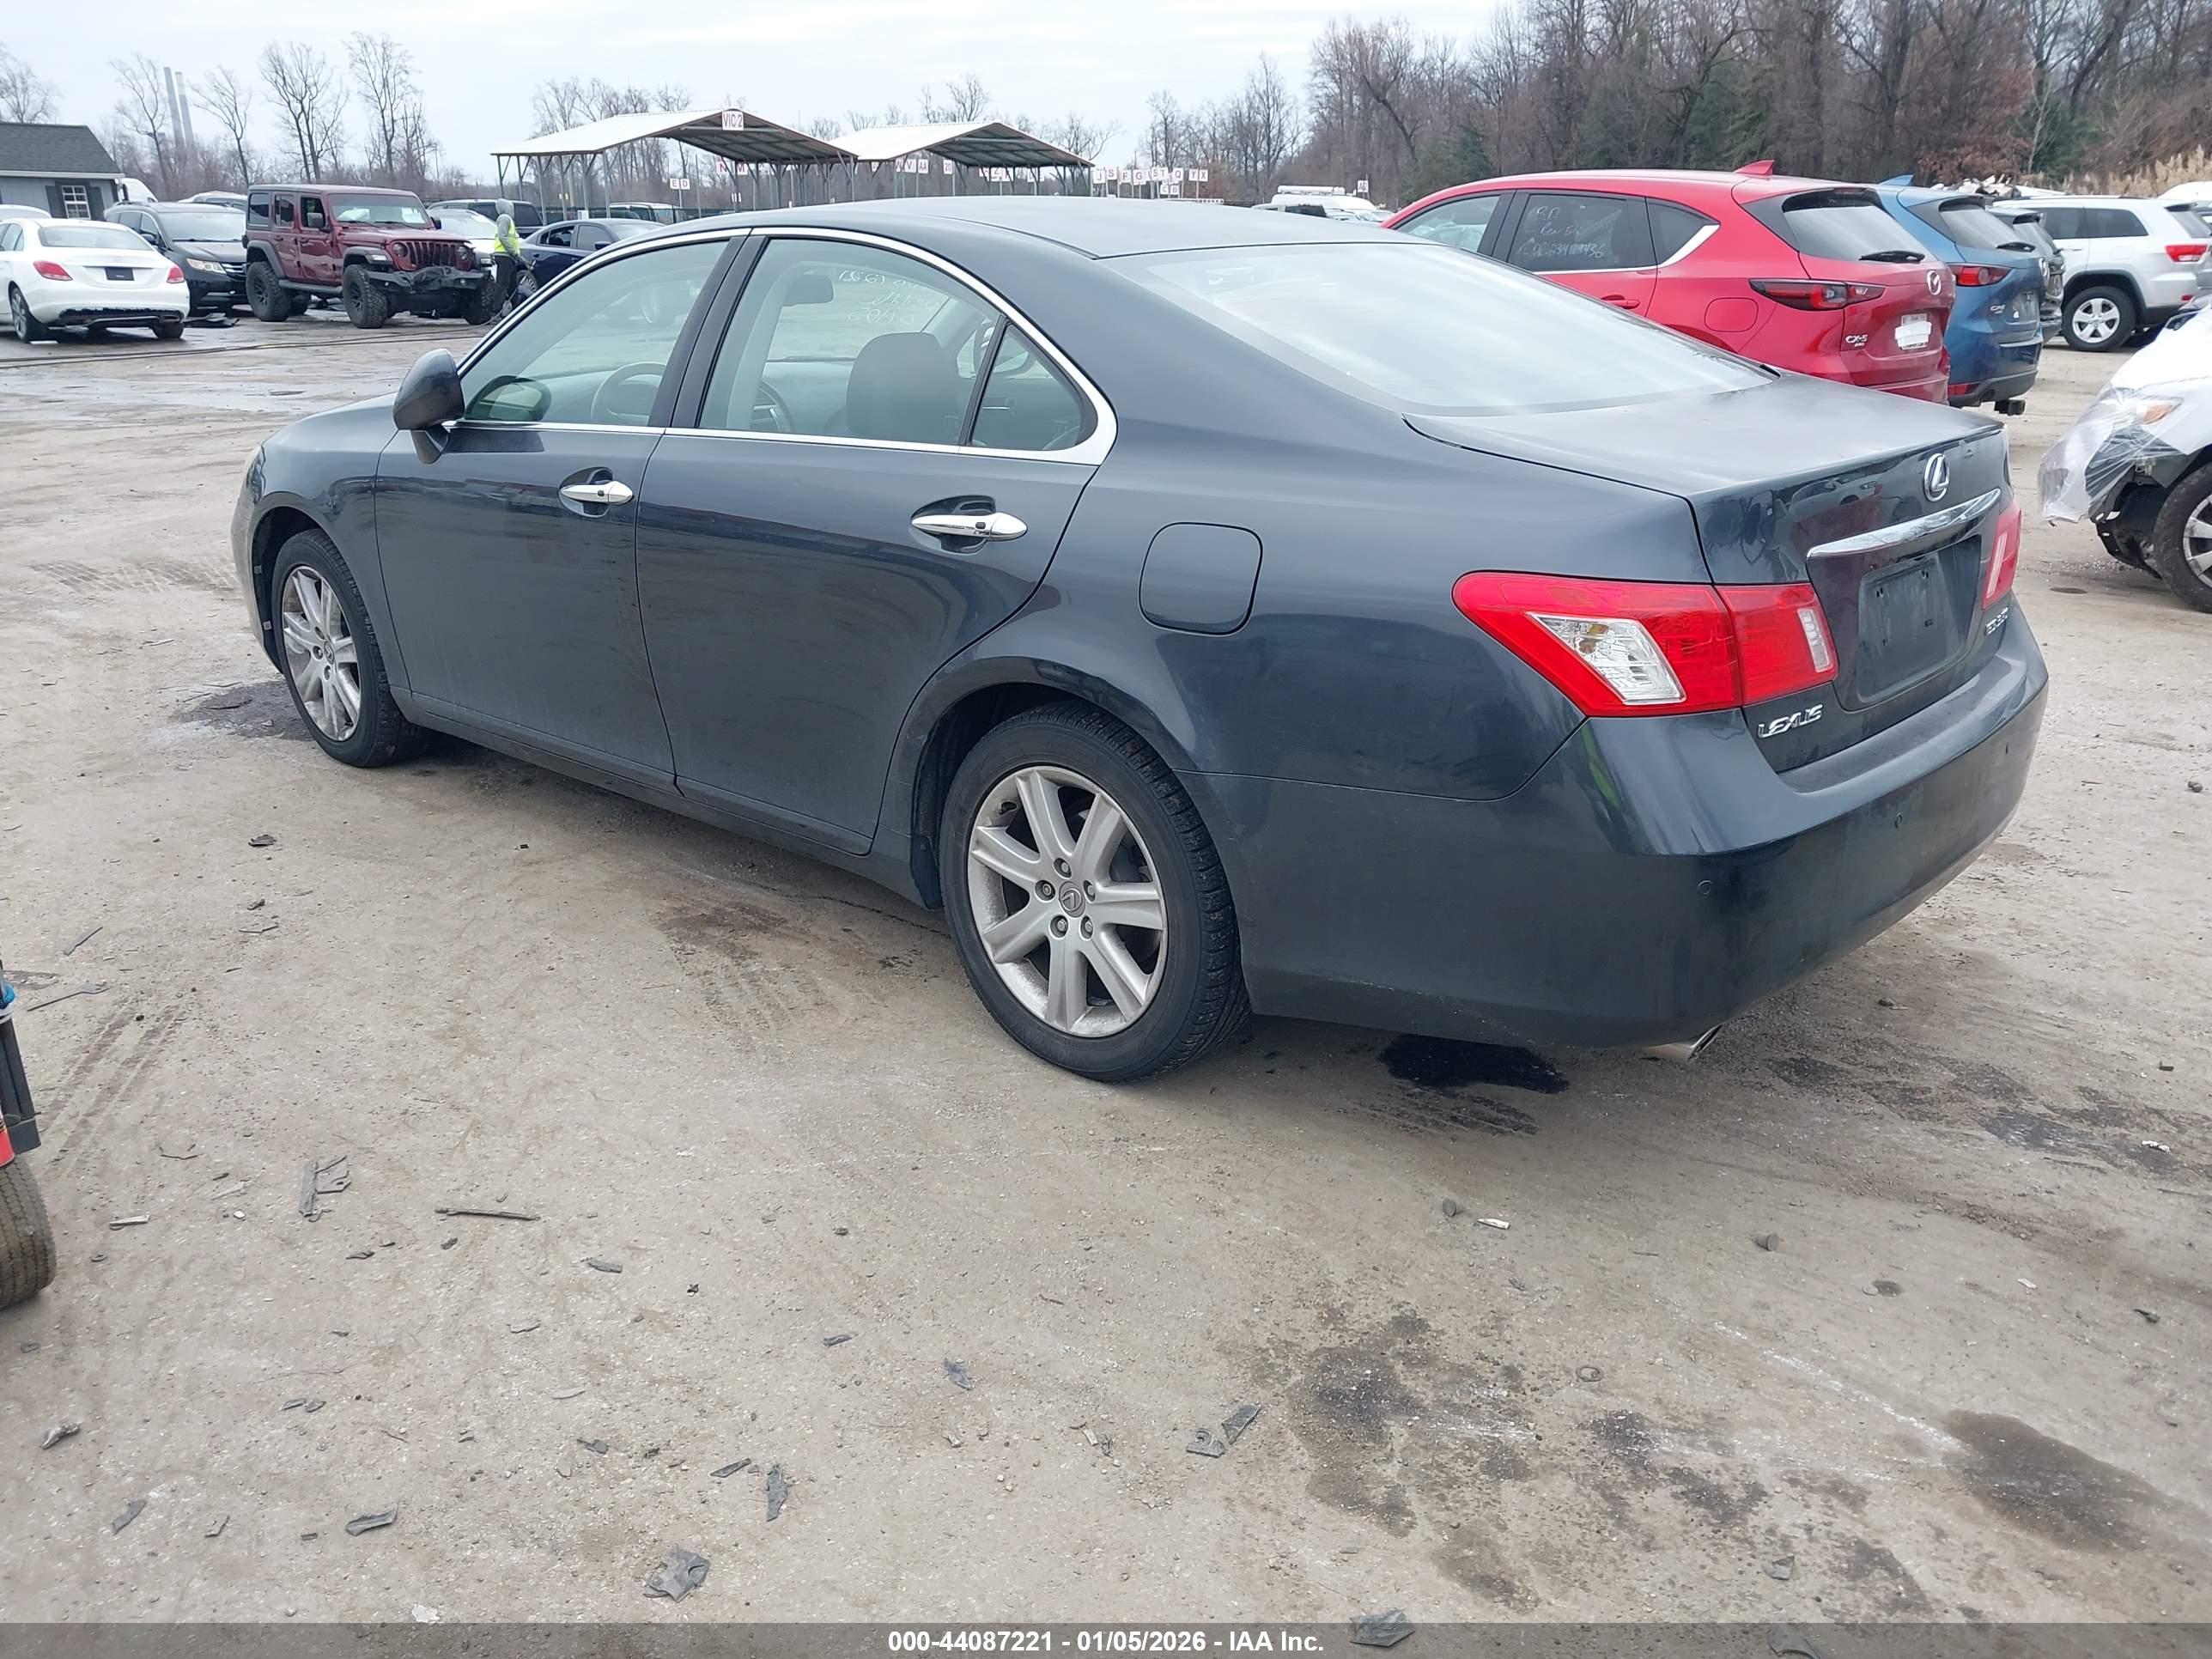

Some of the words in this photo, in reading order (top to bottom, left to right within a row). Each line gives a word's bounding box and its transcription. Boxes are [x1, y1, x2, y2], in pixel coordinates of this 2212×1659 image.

[723, 113, 737, 129] VIC
[737, 114, 743, 128] 2
[1135, 172, 1143, 180] G
[1845, 334, 1869, 343] CX-5
[1758, 704, 1823, 738] LEXUS
